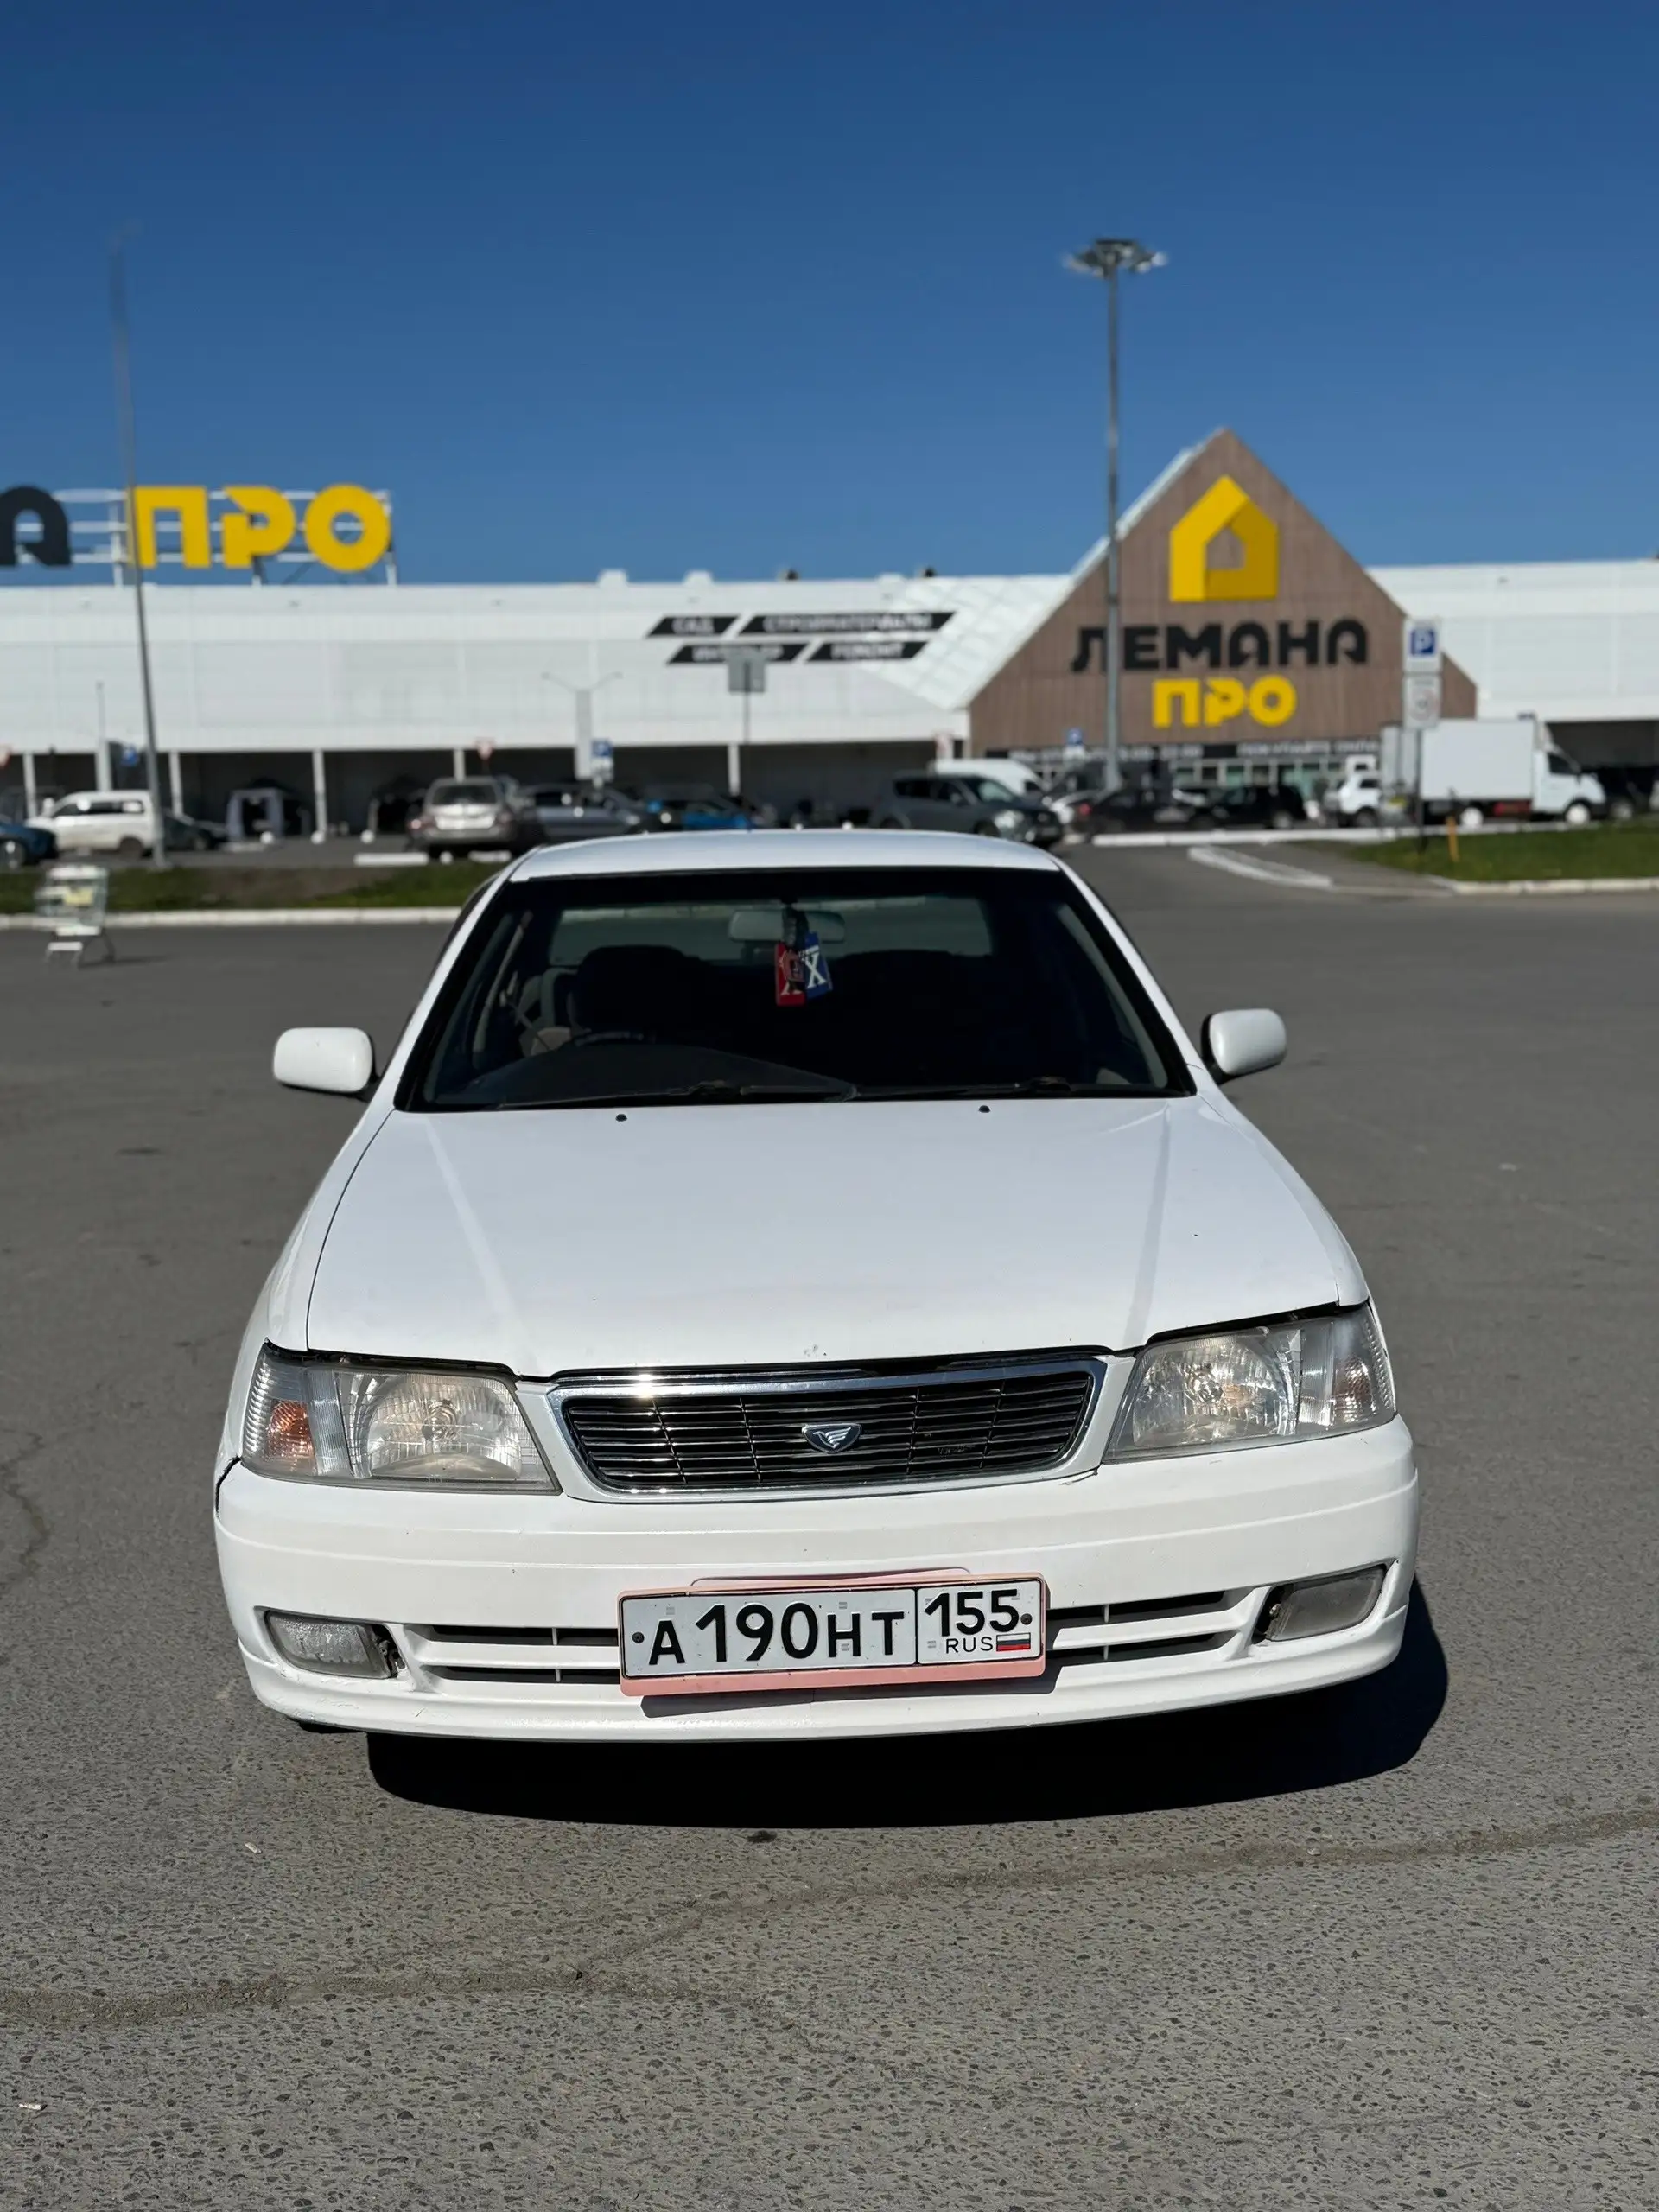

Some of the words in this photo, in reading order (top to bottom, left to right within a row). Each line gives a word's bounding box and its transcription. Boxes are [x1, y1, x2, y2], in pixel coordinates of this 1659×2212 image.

[127, 486, 391, 570] ПРО
[1070, 618, 1370, 674] ЛЕМАНА
[1152, 675, 1299, 731] ПРО
[649, 1602, 905, 1666] А190НТ
[924, 1588, 1020, 1637] 155
[945, 1636, 994, 1654] RUS
